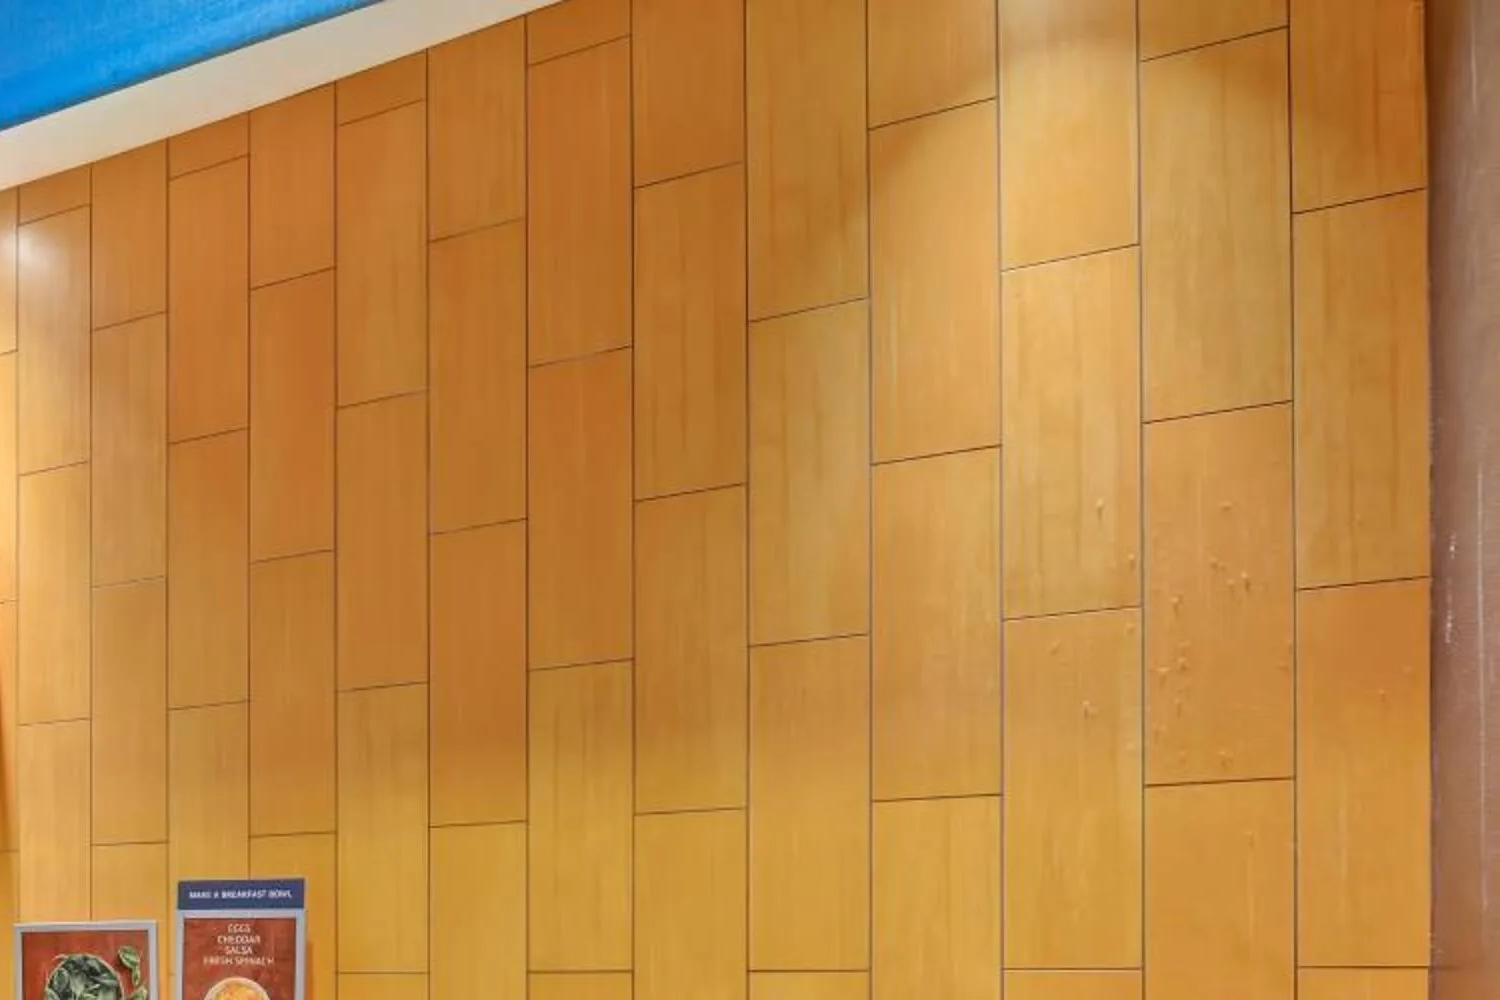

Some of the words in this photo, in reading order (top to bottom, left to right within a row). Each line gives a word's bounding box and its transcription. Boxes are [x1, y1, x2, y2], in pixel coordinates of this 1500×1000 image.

[221, 889, 266, 898] BREAKFAST
[227, 923, 251, 933] EGGS
[217, 935, 261, 944] CHEDDAR
[225, 945, 253, 955] SALSA
[203, 955, 233, 965] FRESH
[236, 956, 275, 966] SPINACH
